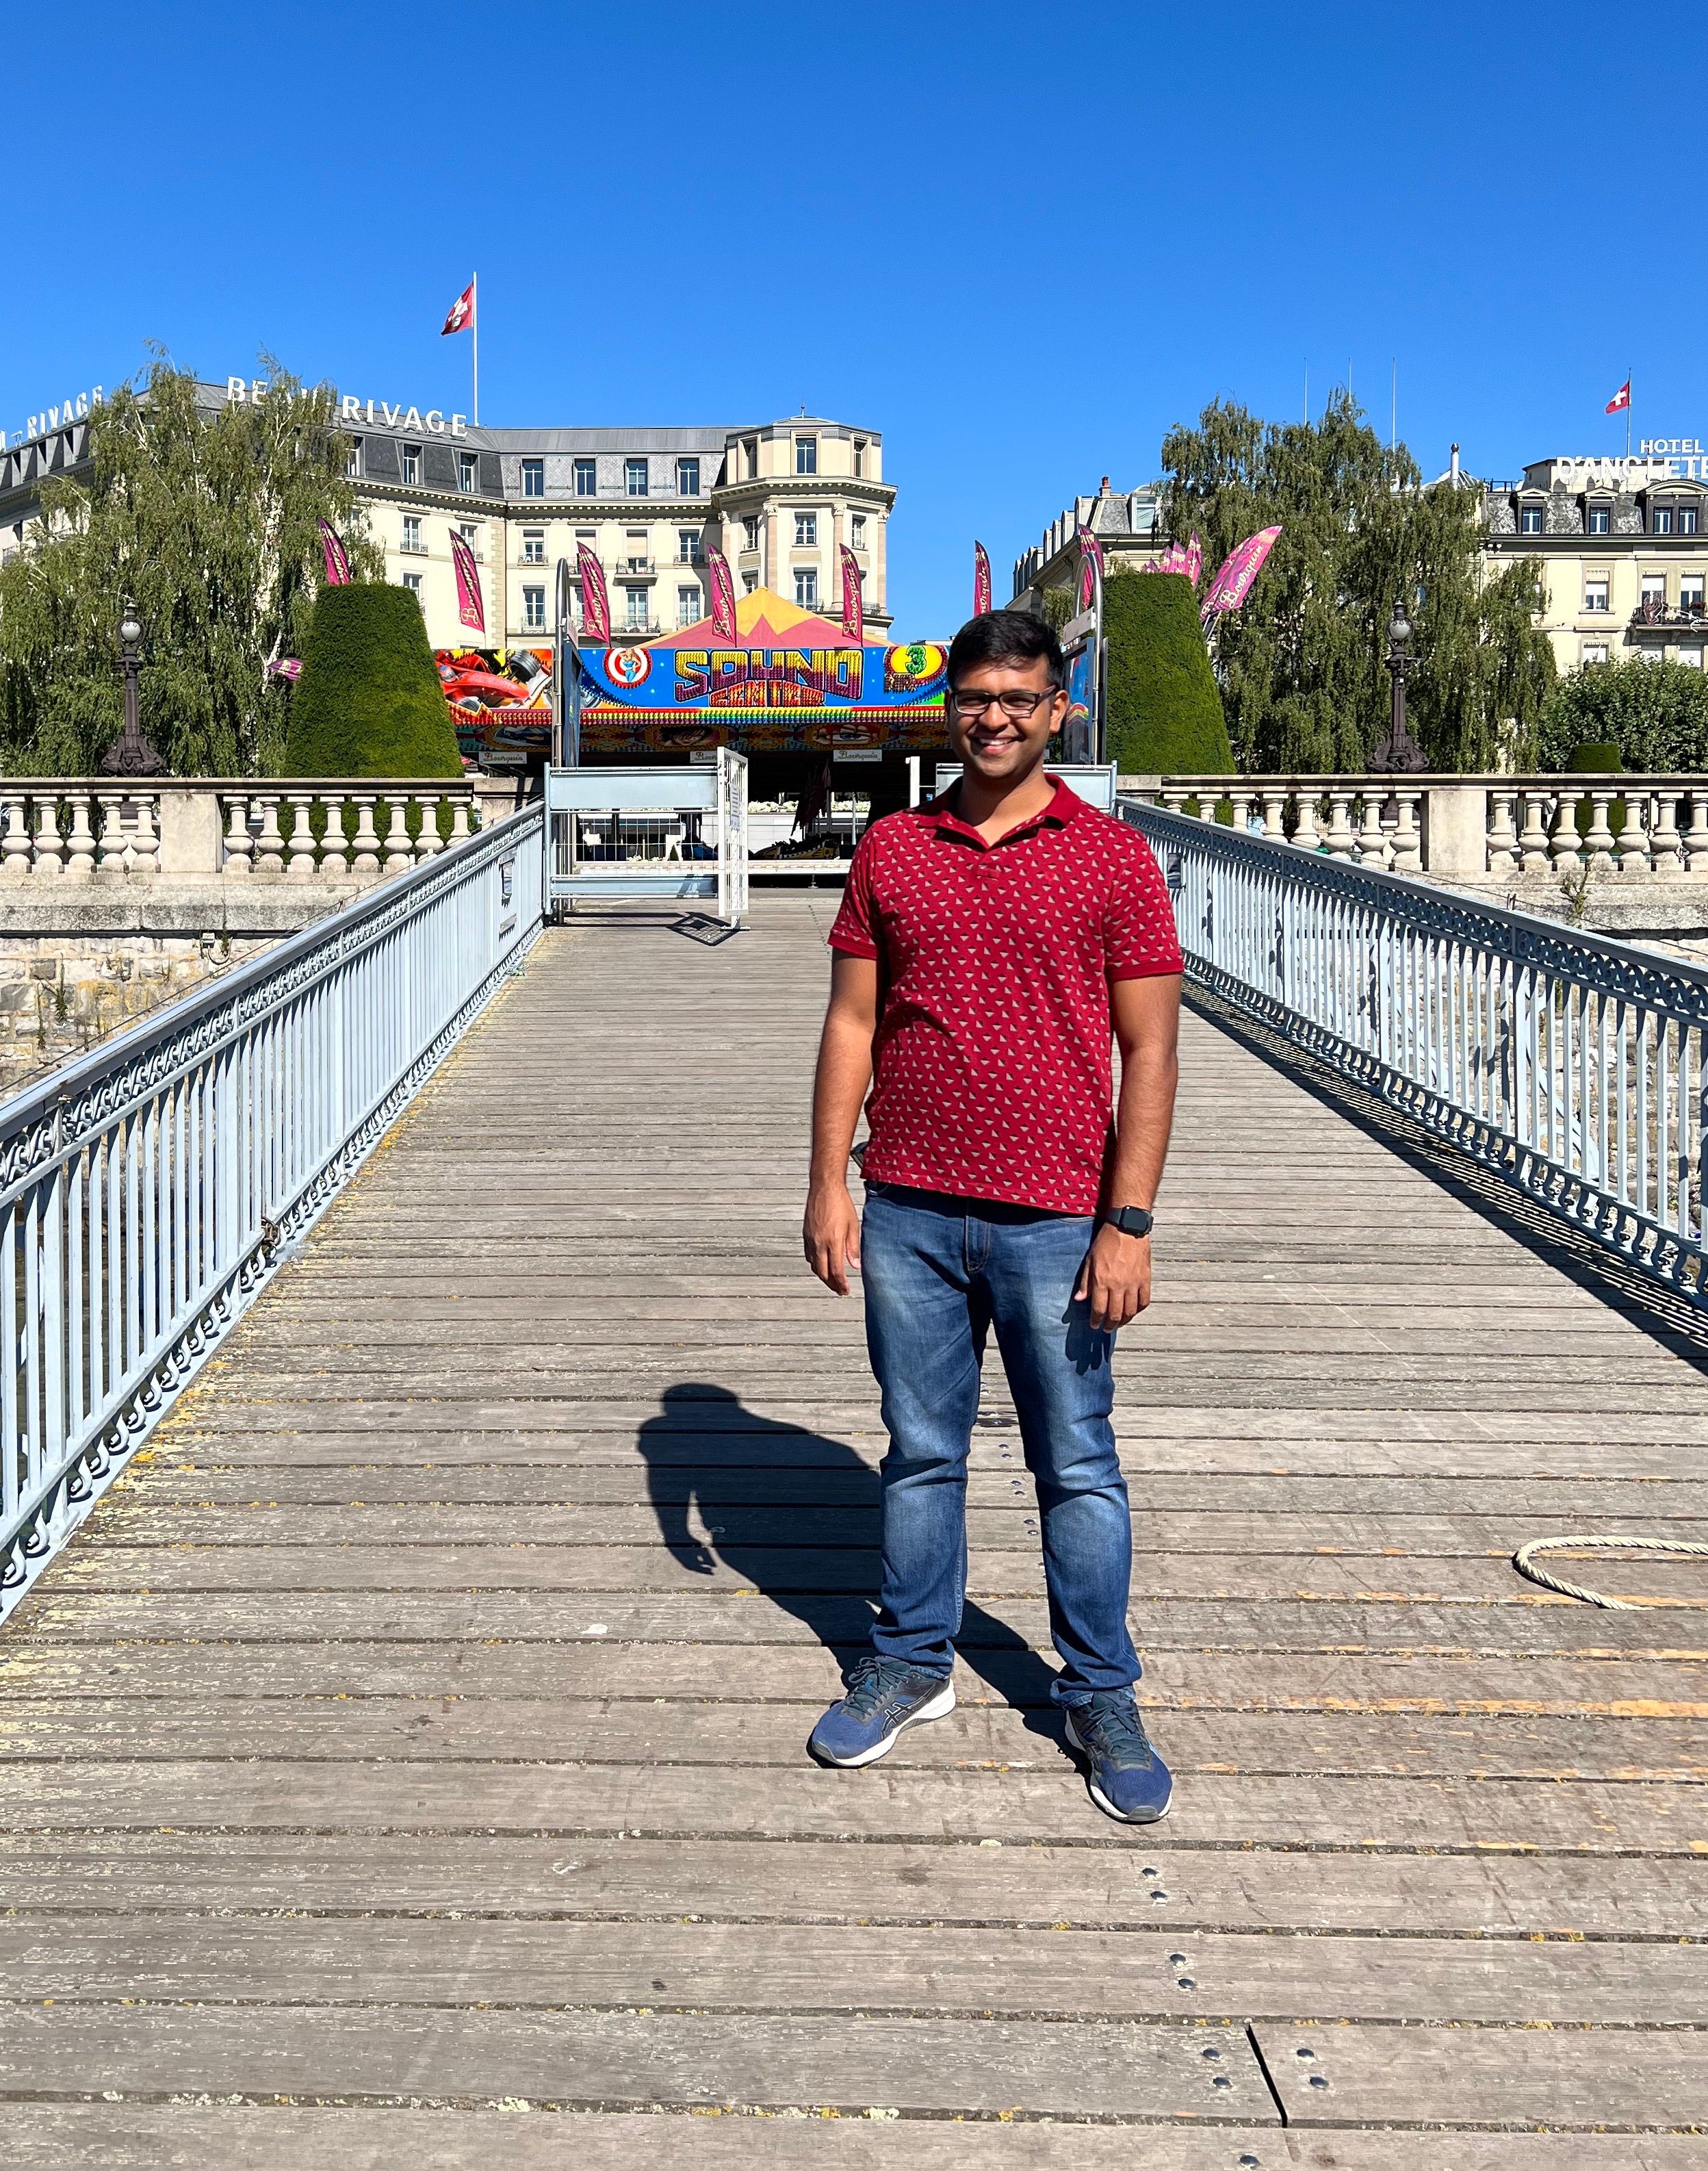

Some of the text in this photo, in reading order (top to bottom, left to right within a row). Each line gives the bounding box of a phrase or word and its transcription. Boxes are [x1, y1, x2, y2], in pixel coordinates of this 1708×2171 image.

[1640, 439, 1705, 454] HOTEL
[905, 645, 927, 674] 3
[675, 650, 864, 702] SOUND
[710, 680, 824, 707] CENTER
